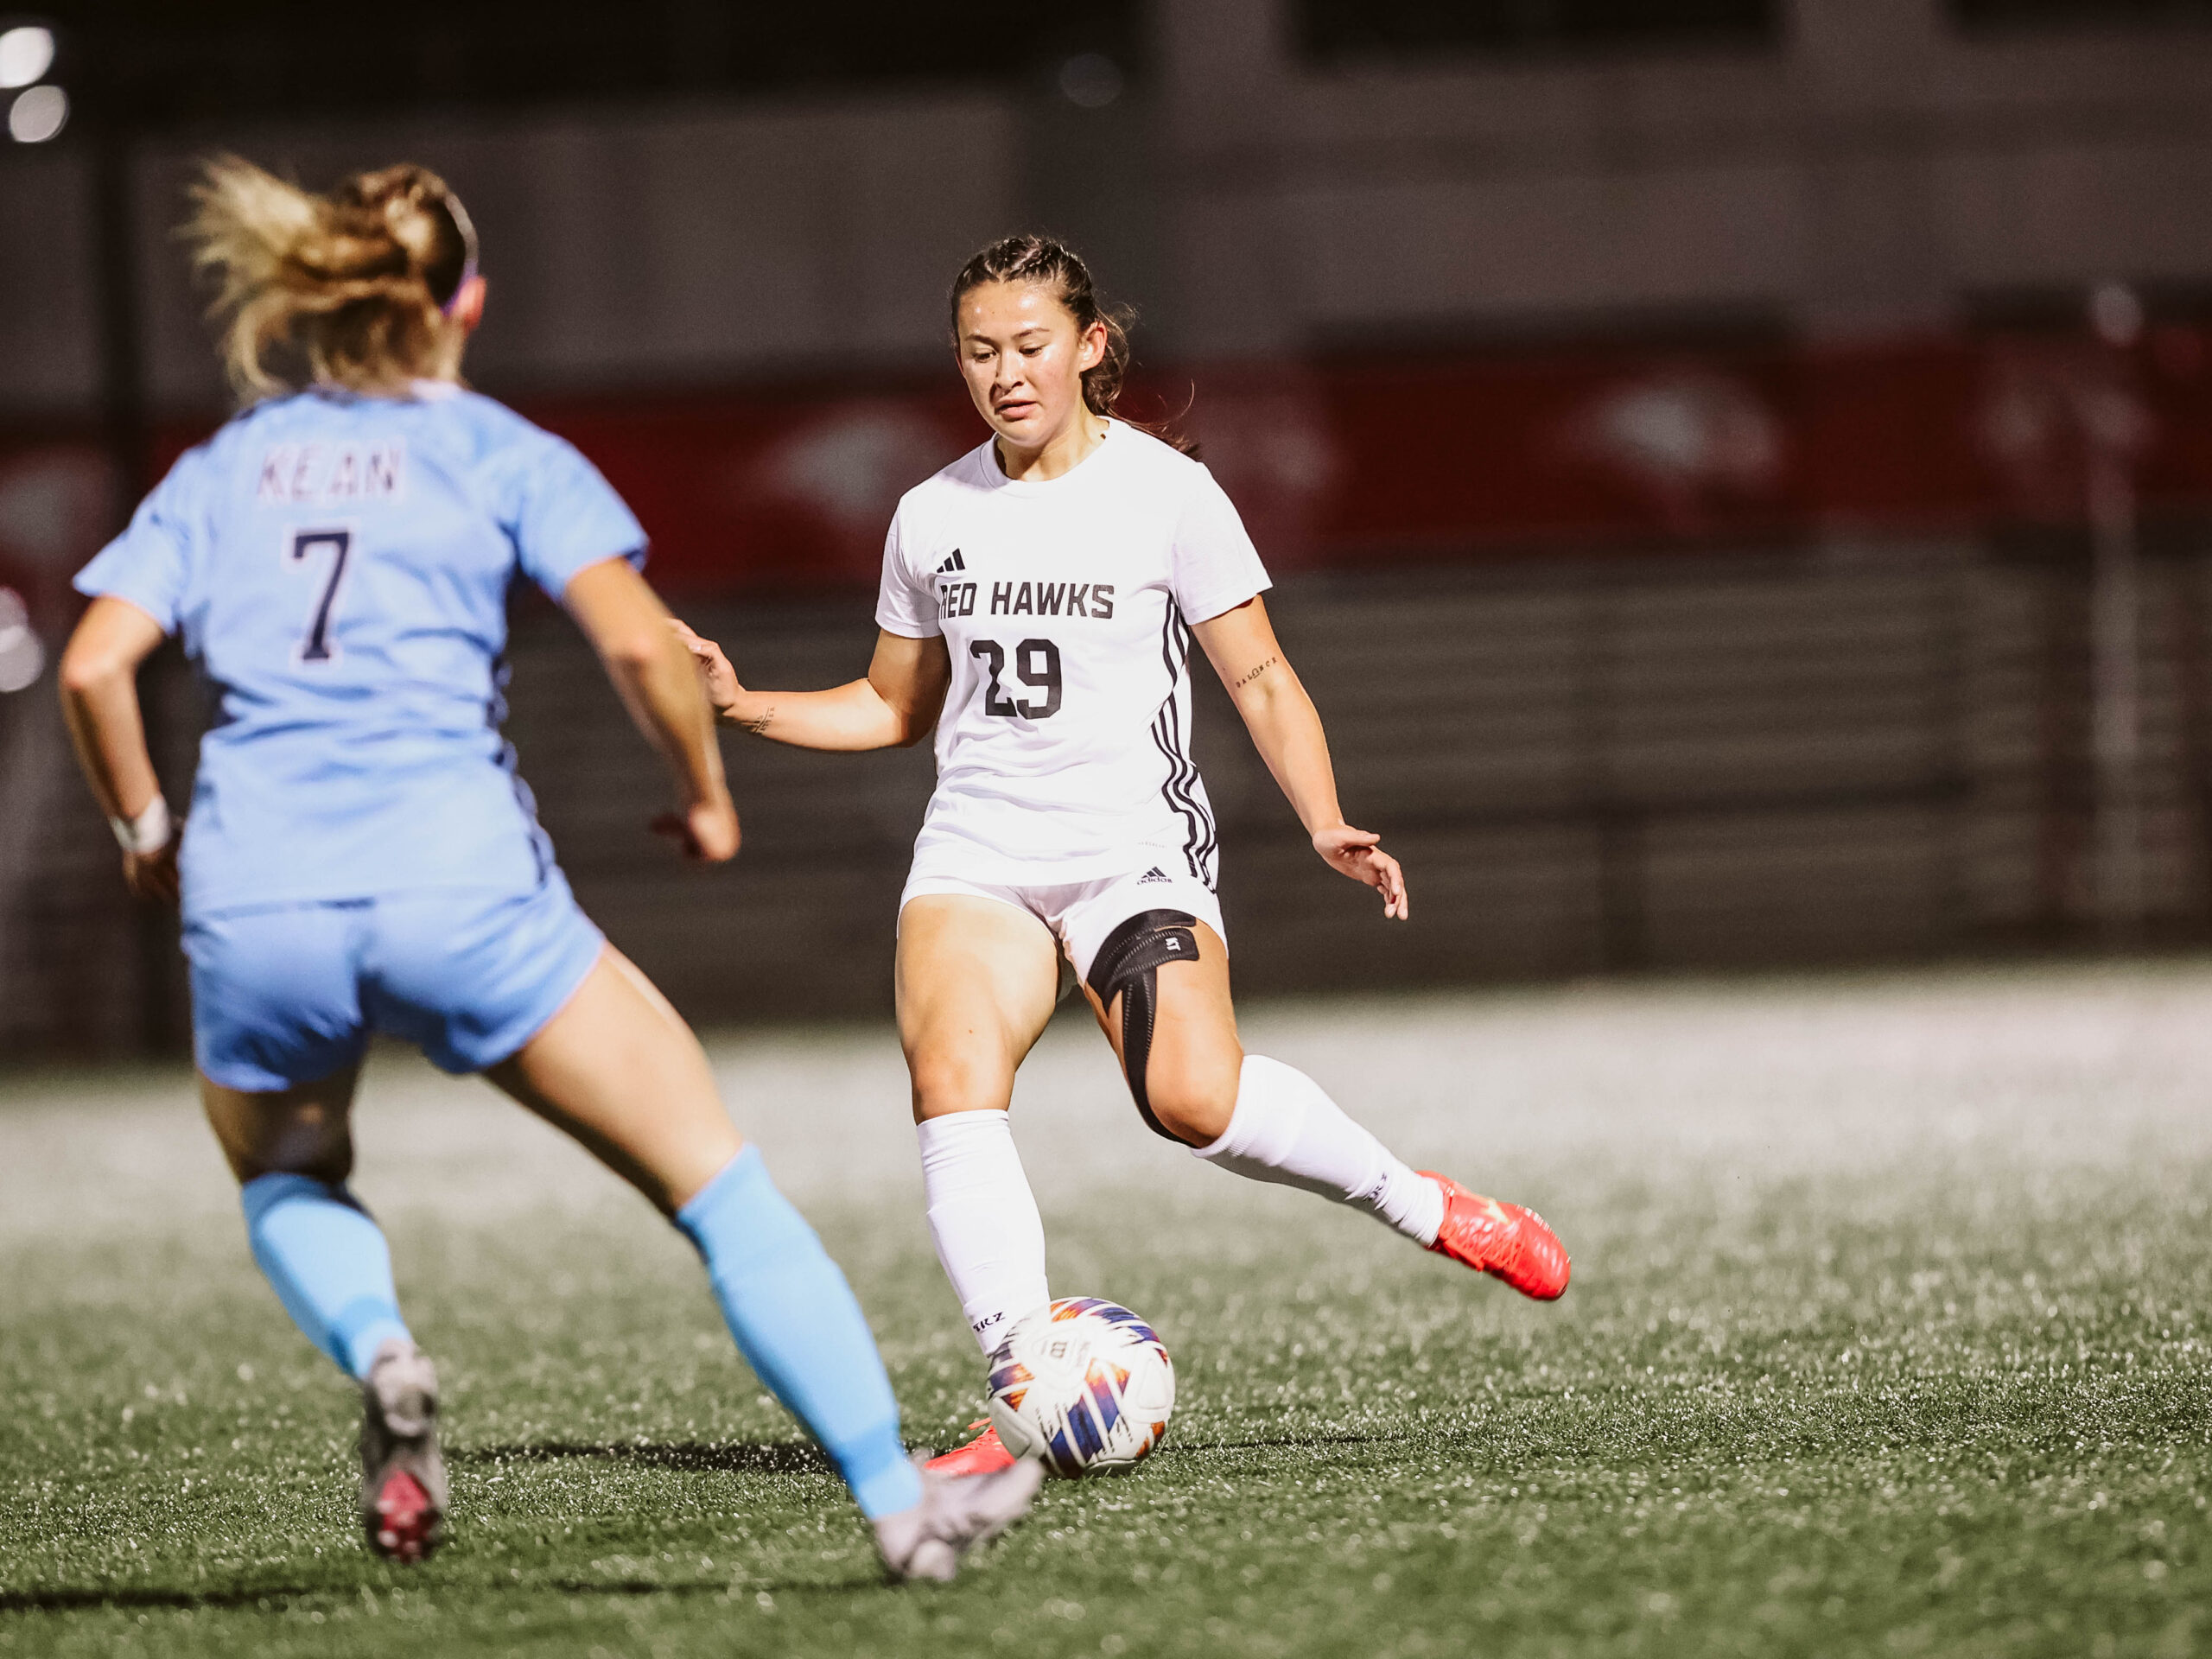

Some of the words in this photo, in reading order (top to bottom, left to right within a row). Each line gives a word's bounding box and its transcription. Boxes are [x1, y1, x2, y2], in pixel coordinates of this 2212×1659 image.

[257, 440, 404, 503] KEAN
[290, 526, 352, 664] 7
[939, 582, 978, 620] RED
[989, 581, 1116, 620] HAWKS
[969, 638, 1063, 720] 29
